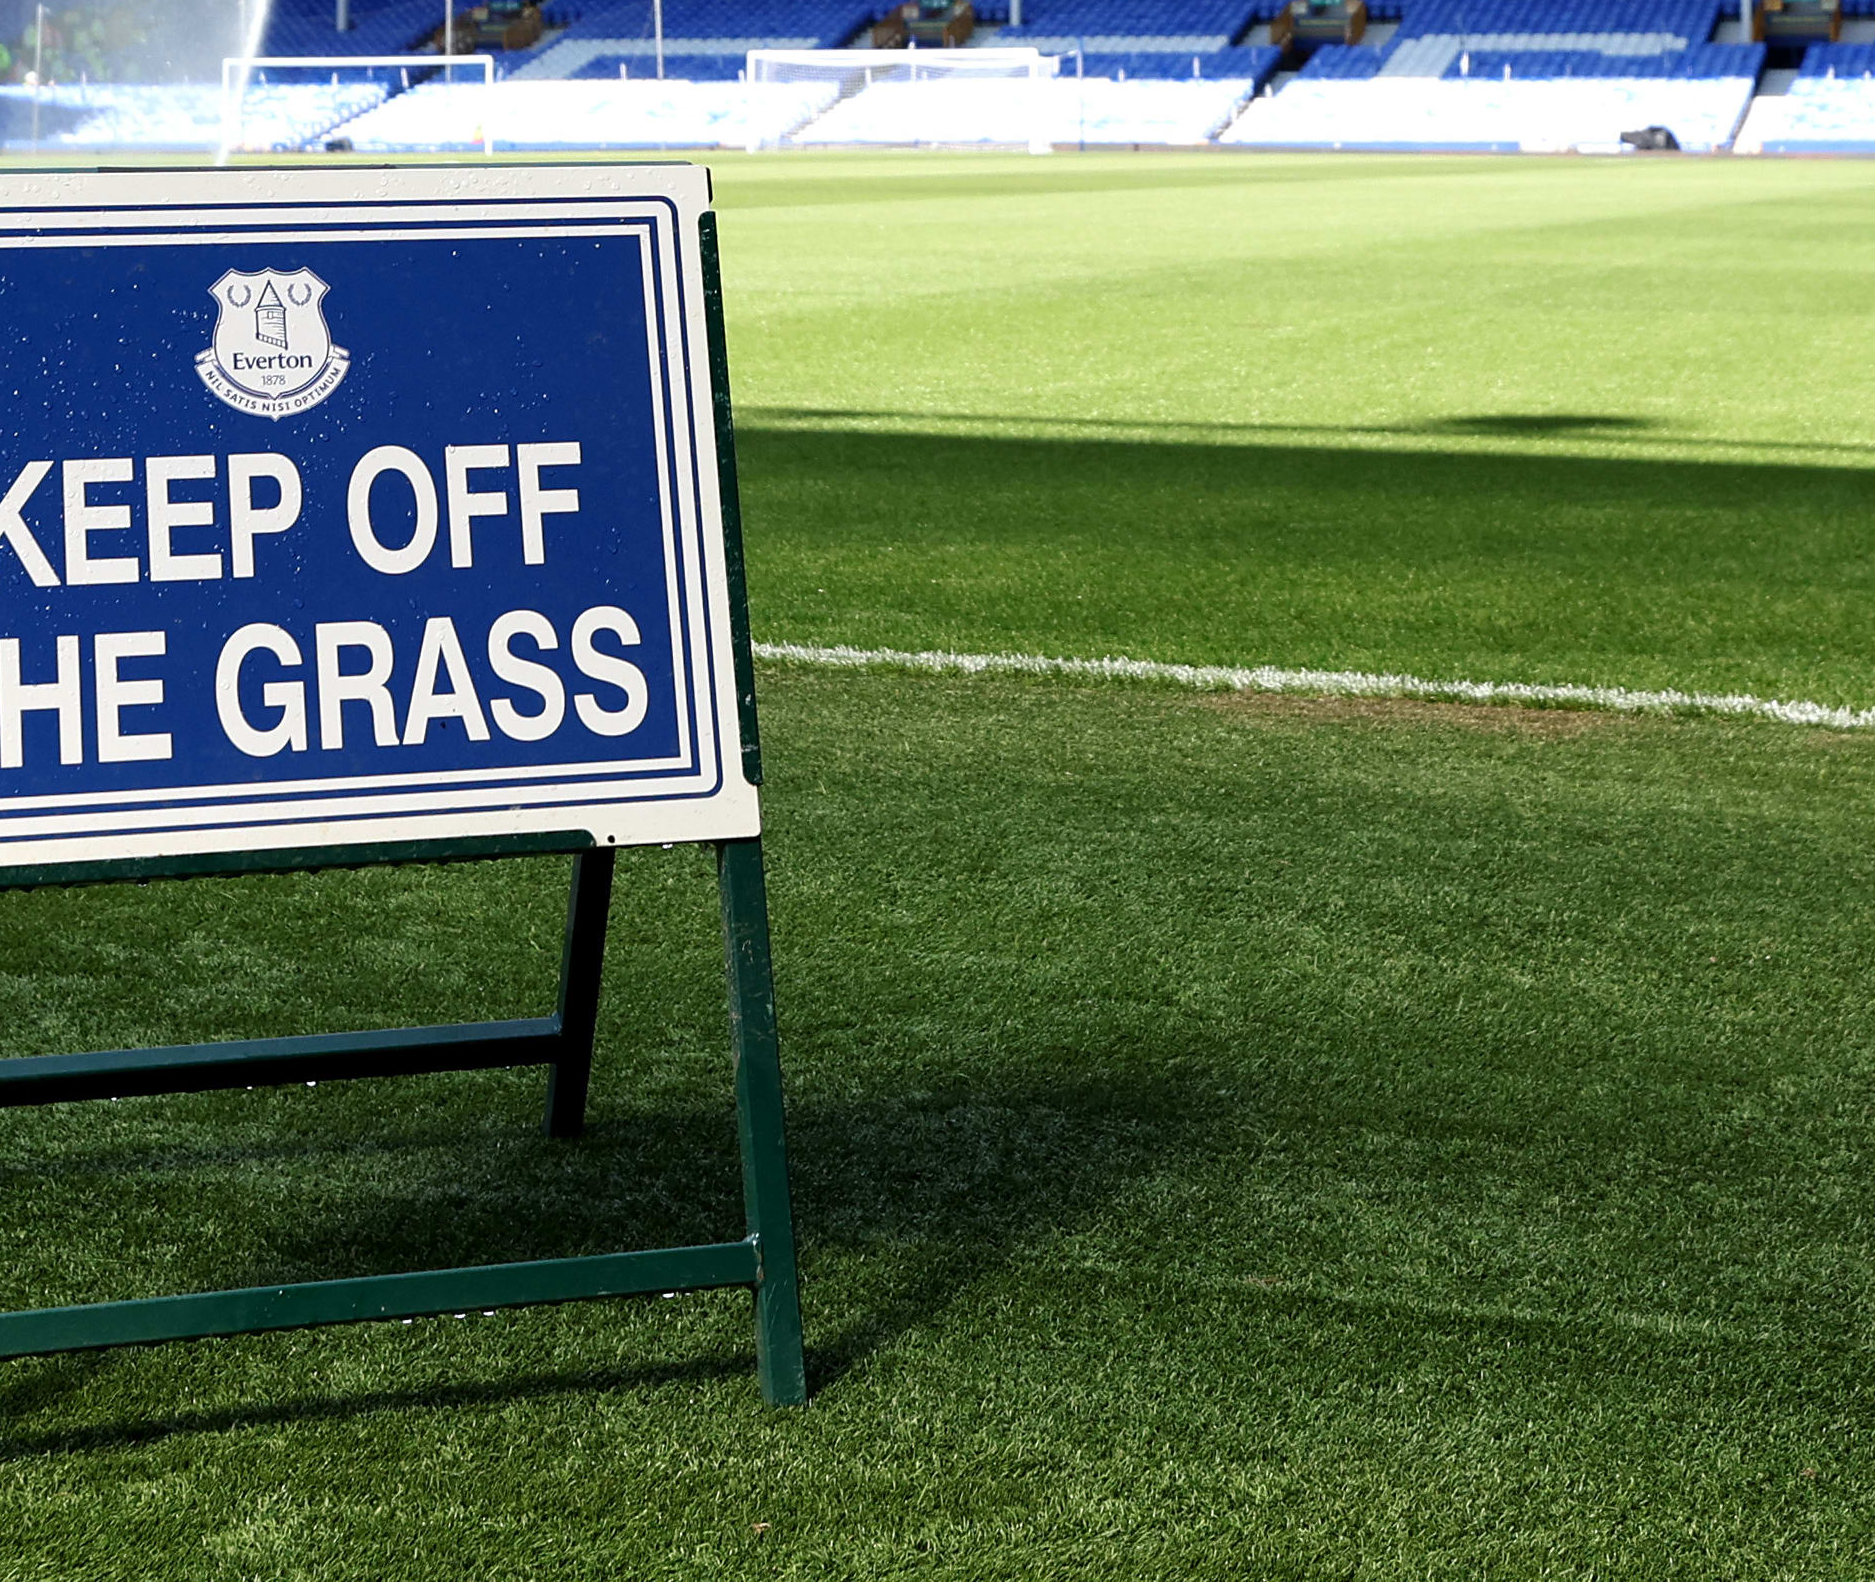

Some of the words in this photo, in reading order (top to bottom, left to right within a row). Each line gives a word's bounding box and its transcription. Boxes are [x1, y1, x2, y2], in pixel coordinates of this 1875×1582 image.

[232, 352, 313, 369] Everton
[261, 374, 286, 386] 1878
[205, 370, 222, 392] NIL
[223, 389, 257, 410] SATIS
[261, 401, 290, 412] NISI
[294, 367, 342, 408] OPTIMUM
[346, 440, 582, 575] OFF
[214, 604, 650, 759] GRASS
